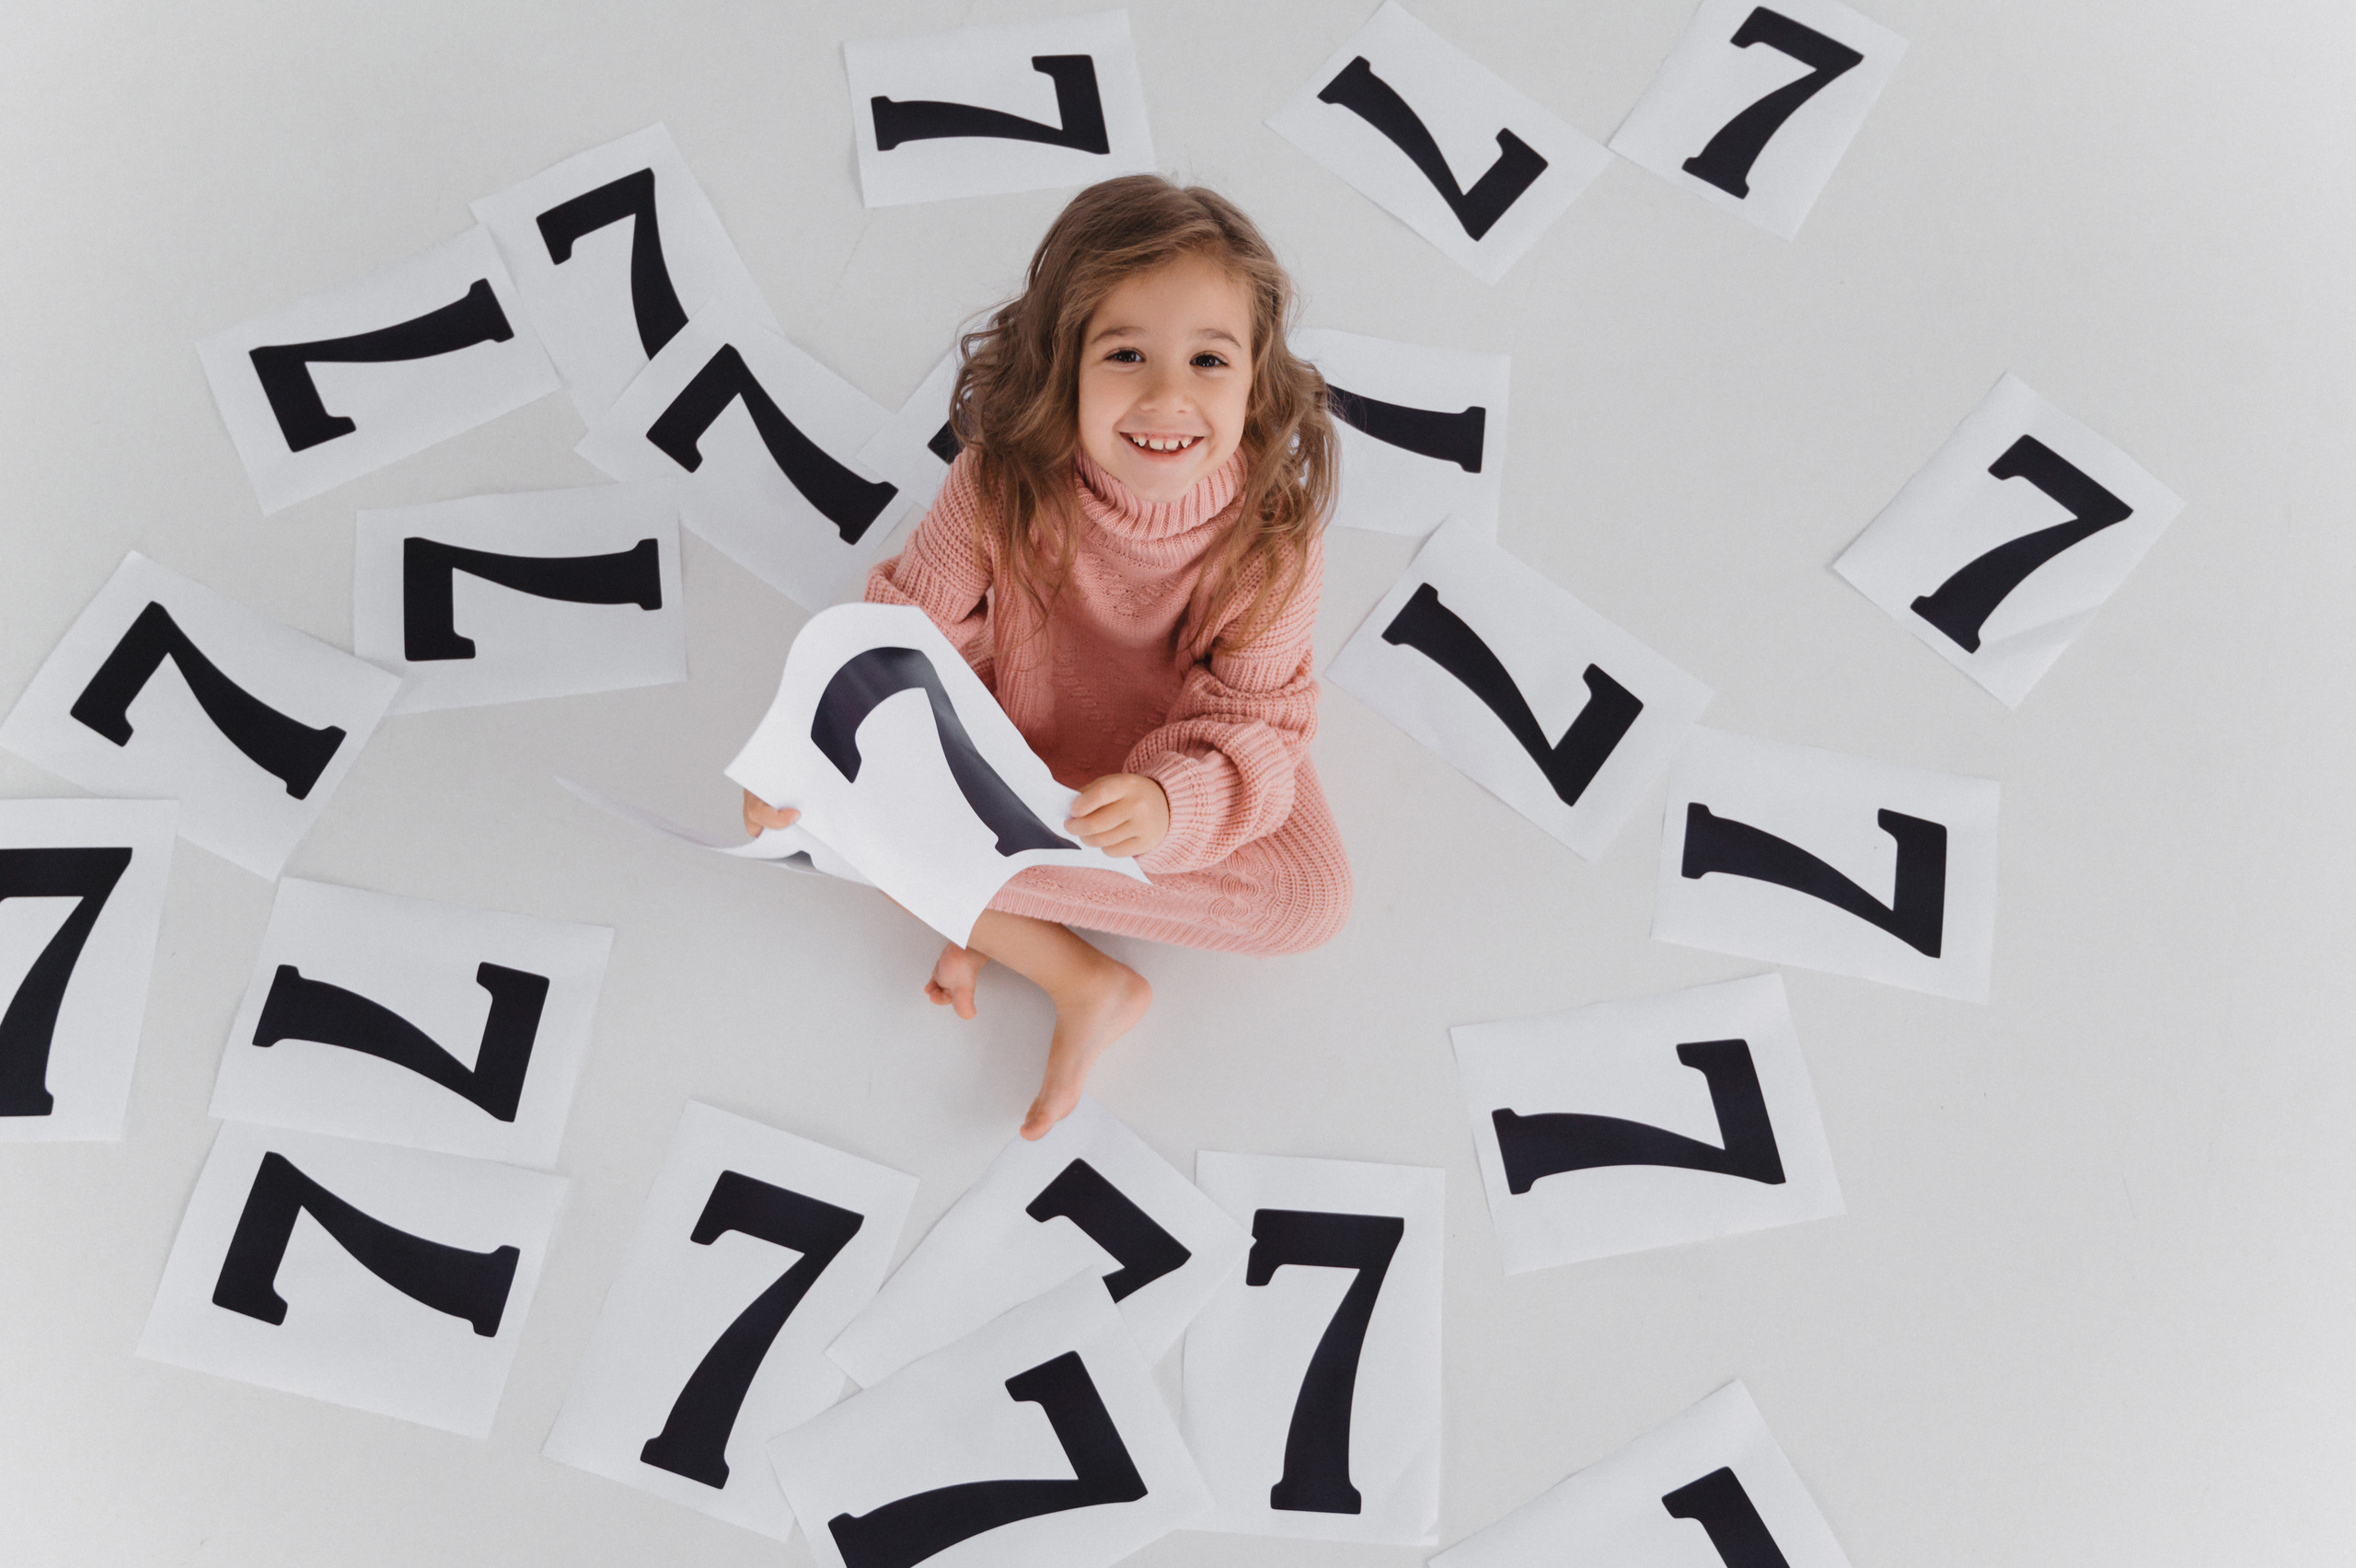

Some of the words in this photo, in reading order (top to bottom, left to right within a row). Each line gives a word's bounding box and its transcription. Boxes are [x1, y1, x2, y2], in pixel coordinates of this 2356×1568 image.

[872, 54, 1110, 155] 7
[1318, 55, 1548, 242] 7
[1682, 6, 1864, 199] 7
[537, 167, 689, 361] 7
[249, 278, 514, 453] 7
[646, 343, 899, 546] 7
[403, 536, 663, 662] 7
[1911, 434, 2133, 654] 7
[71, 601, 347, 801] 7
[811, 646, 1082, 858] 7
[1382, 582, 1644, 807] 7
[1682, 802, 1947, 959] 7
[0, 847, 133, 1117] 7
[252, 962, 550, 1123] 7
[1492, 1039, 1786, 1195] 7
[213, 1151, 520, 1338] 7
[641, 1170, 865, 1490] 7
[1246, 1208, 1404, 1515] 7
[828, 1351, 1149, 1568] 7
